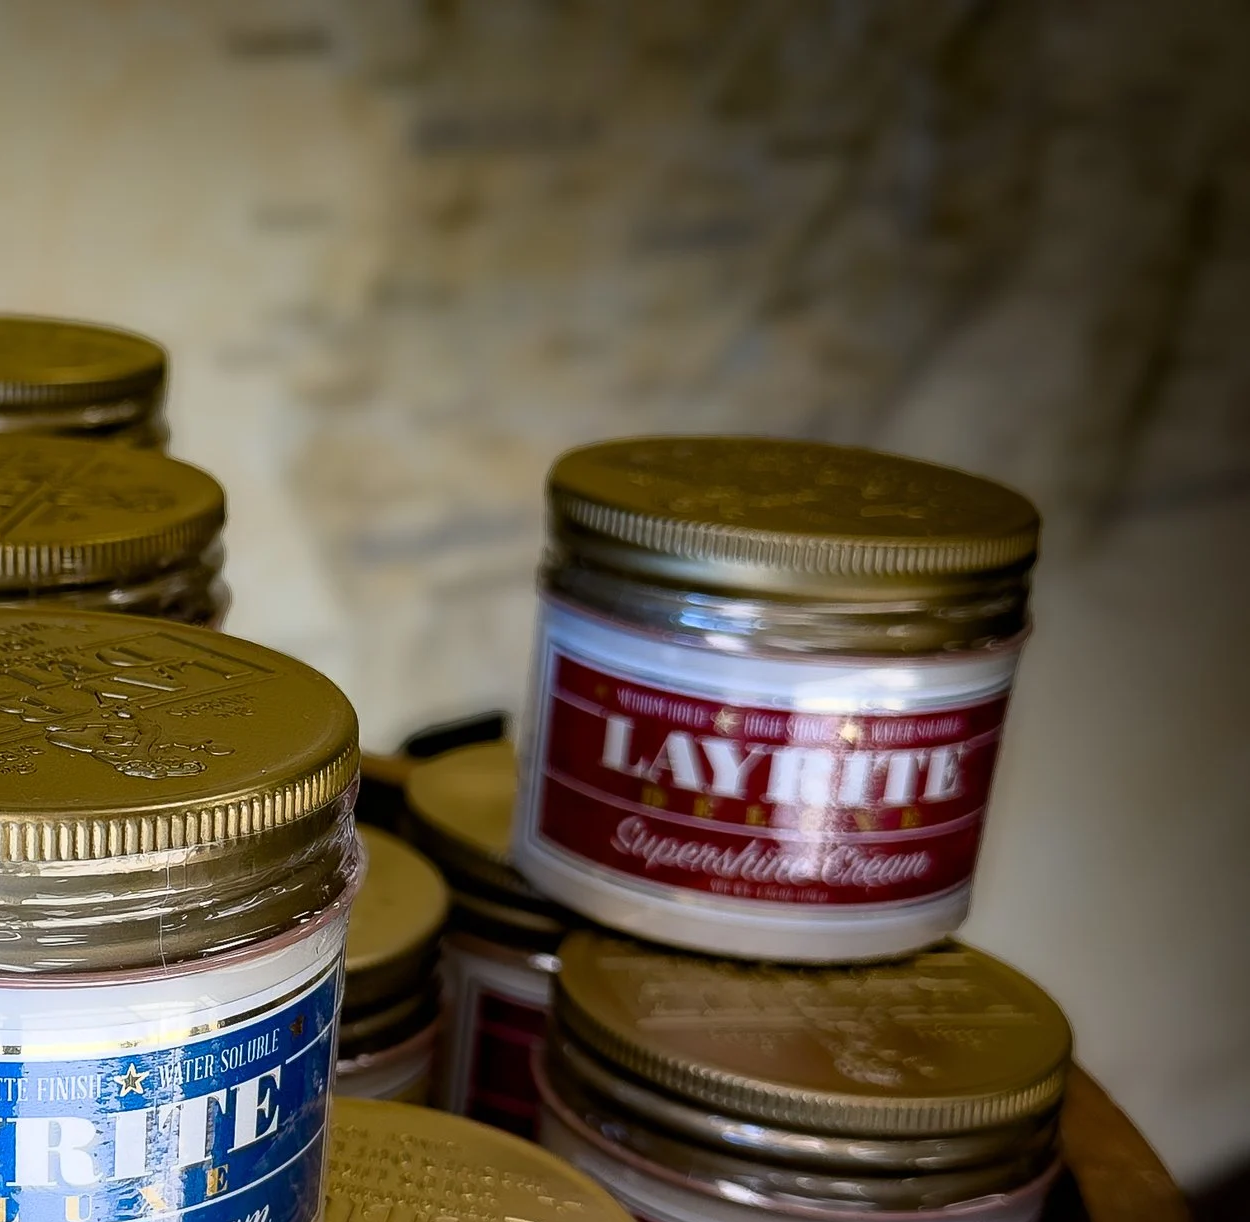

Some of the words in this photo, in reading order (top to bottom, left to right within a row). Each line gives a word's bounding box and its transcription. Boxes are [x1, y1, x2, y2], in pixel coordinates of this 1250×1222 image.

[600, 714, 965, 808] LAYRITE
[37, 1074, 103, 1101] FINISH
[158, 1059, 214, 1088] WATER
[220, 1028, 280, 1073] SOLUBLE
